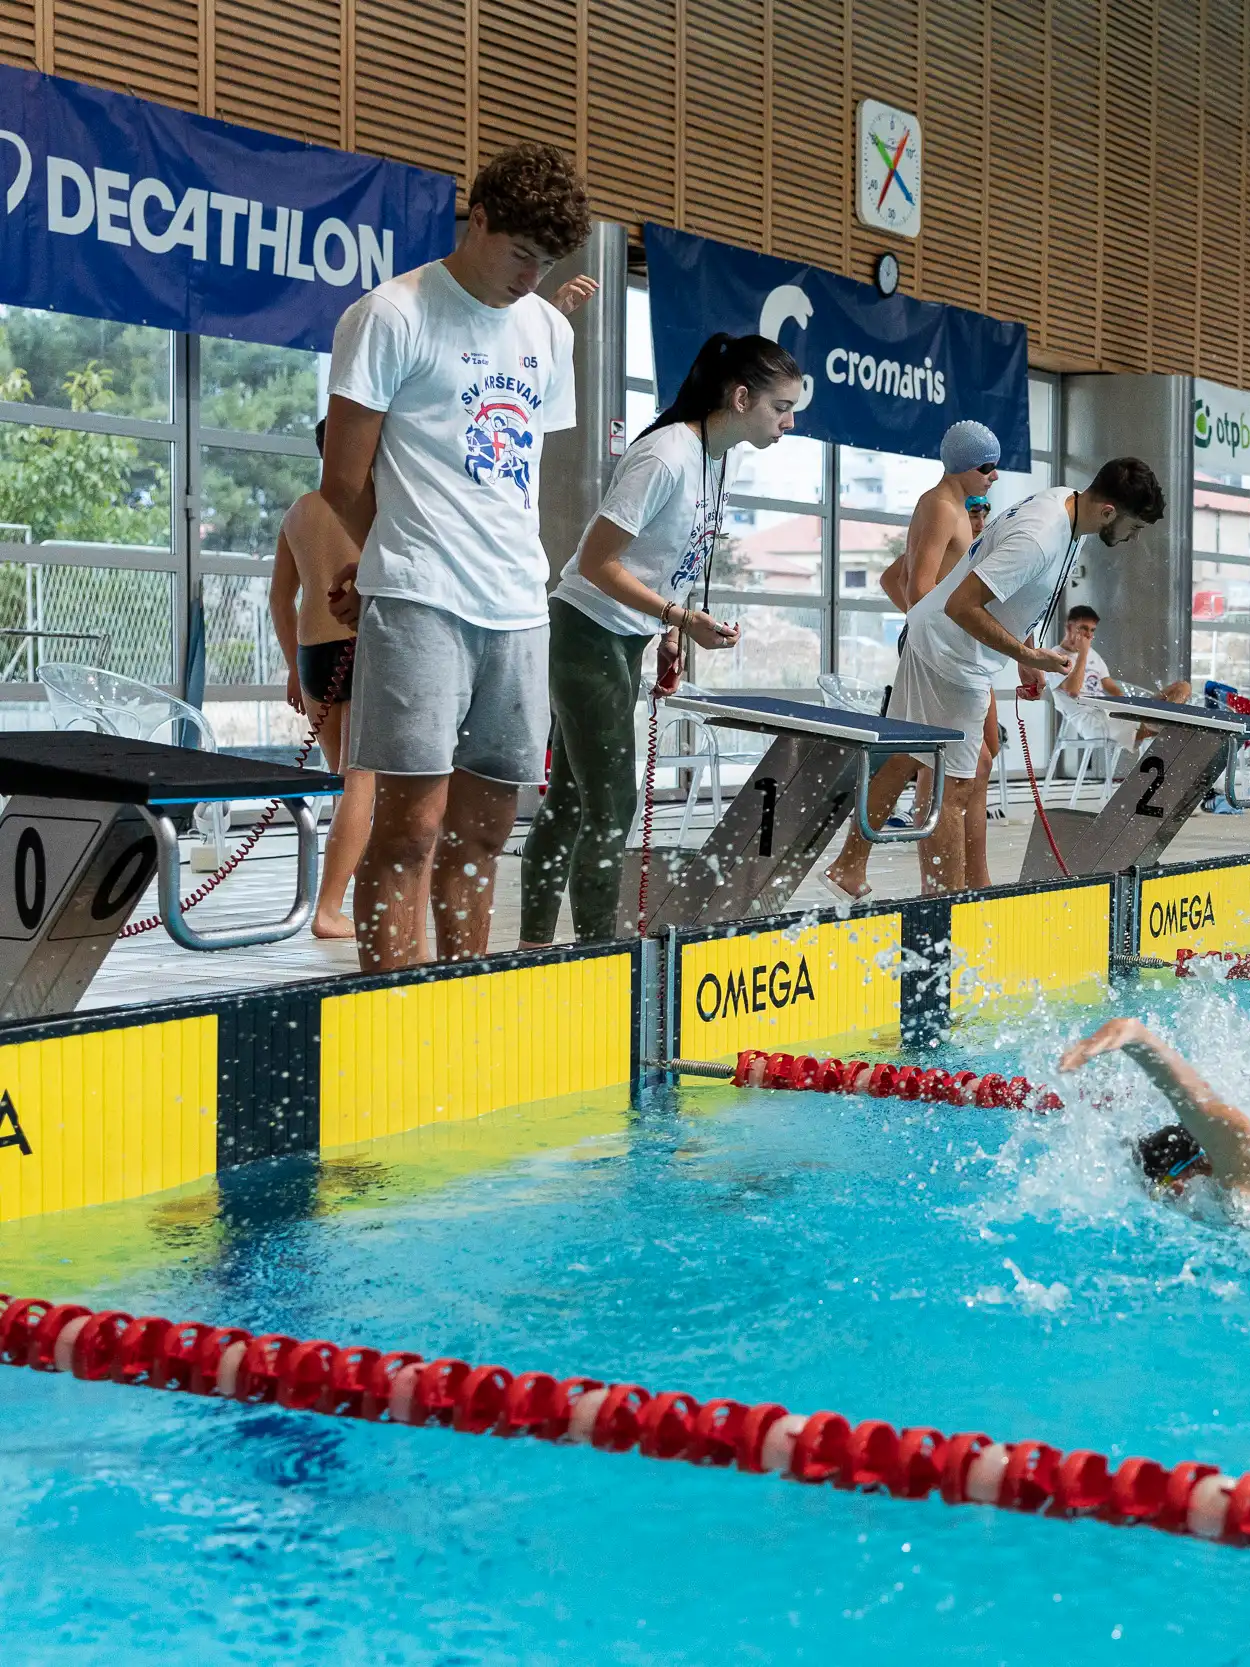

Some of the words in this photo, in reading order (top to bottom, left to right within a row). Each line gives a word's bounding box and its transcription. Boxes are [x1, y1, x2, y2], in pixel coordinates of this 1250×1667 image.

[47, 155, 394, 290] DECATHLON
[461, 383, 484, 405] SV.
[484, 372, 542, 410] KRŠEVAN
[826, 348, 946, 404] cromaris
[754, 777, 778, 857] 1
[1136, 756, 1164, 818] 2
[15, 827, 46, 930] 0
[1149, 891, 1215, 938] OMEGA
[696, 954, 815, 1022] OMEGA
